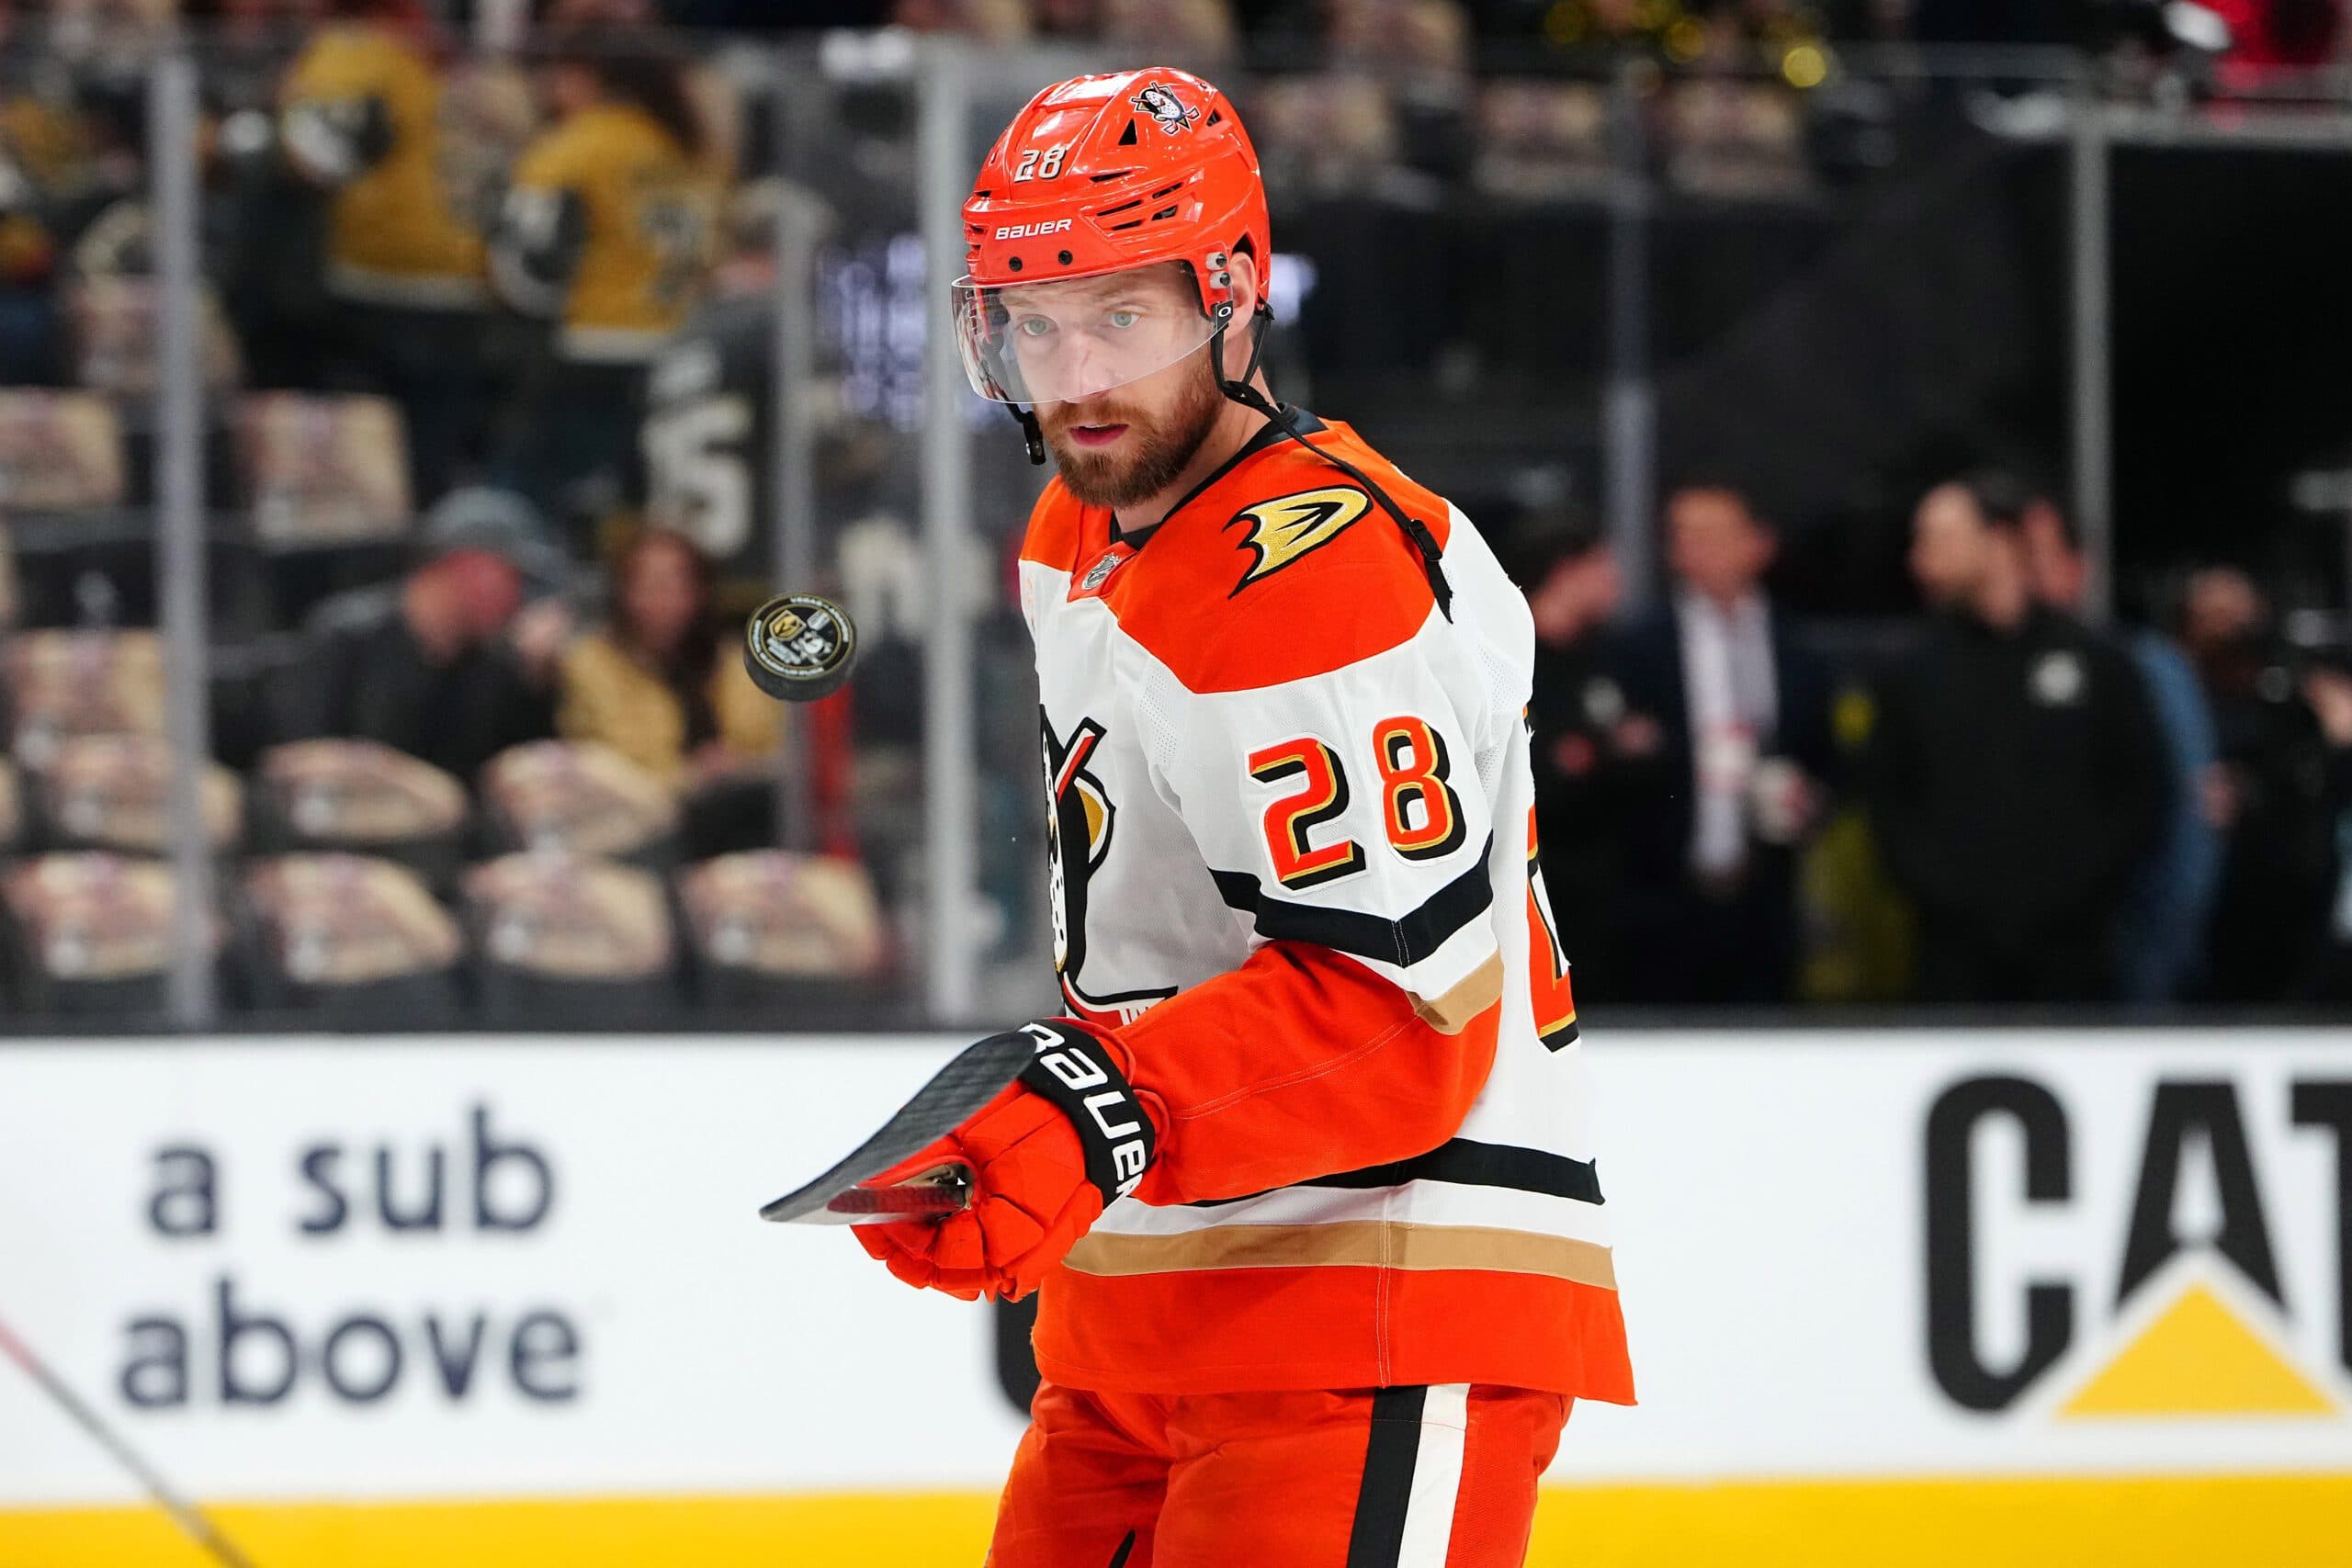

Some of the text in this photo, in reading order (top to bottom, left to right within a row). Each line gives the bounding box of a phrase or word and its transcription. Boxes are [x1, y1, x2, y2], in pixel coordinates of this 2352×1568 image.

[1013, 147, 1069, 184] 28
[1244, 712, 1470, 895] 28
[146, 1105, 553, 1237] a sub
[119, 1278, 579, 1410] above
